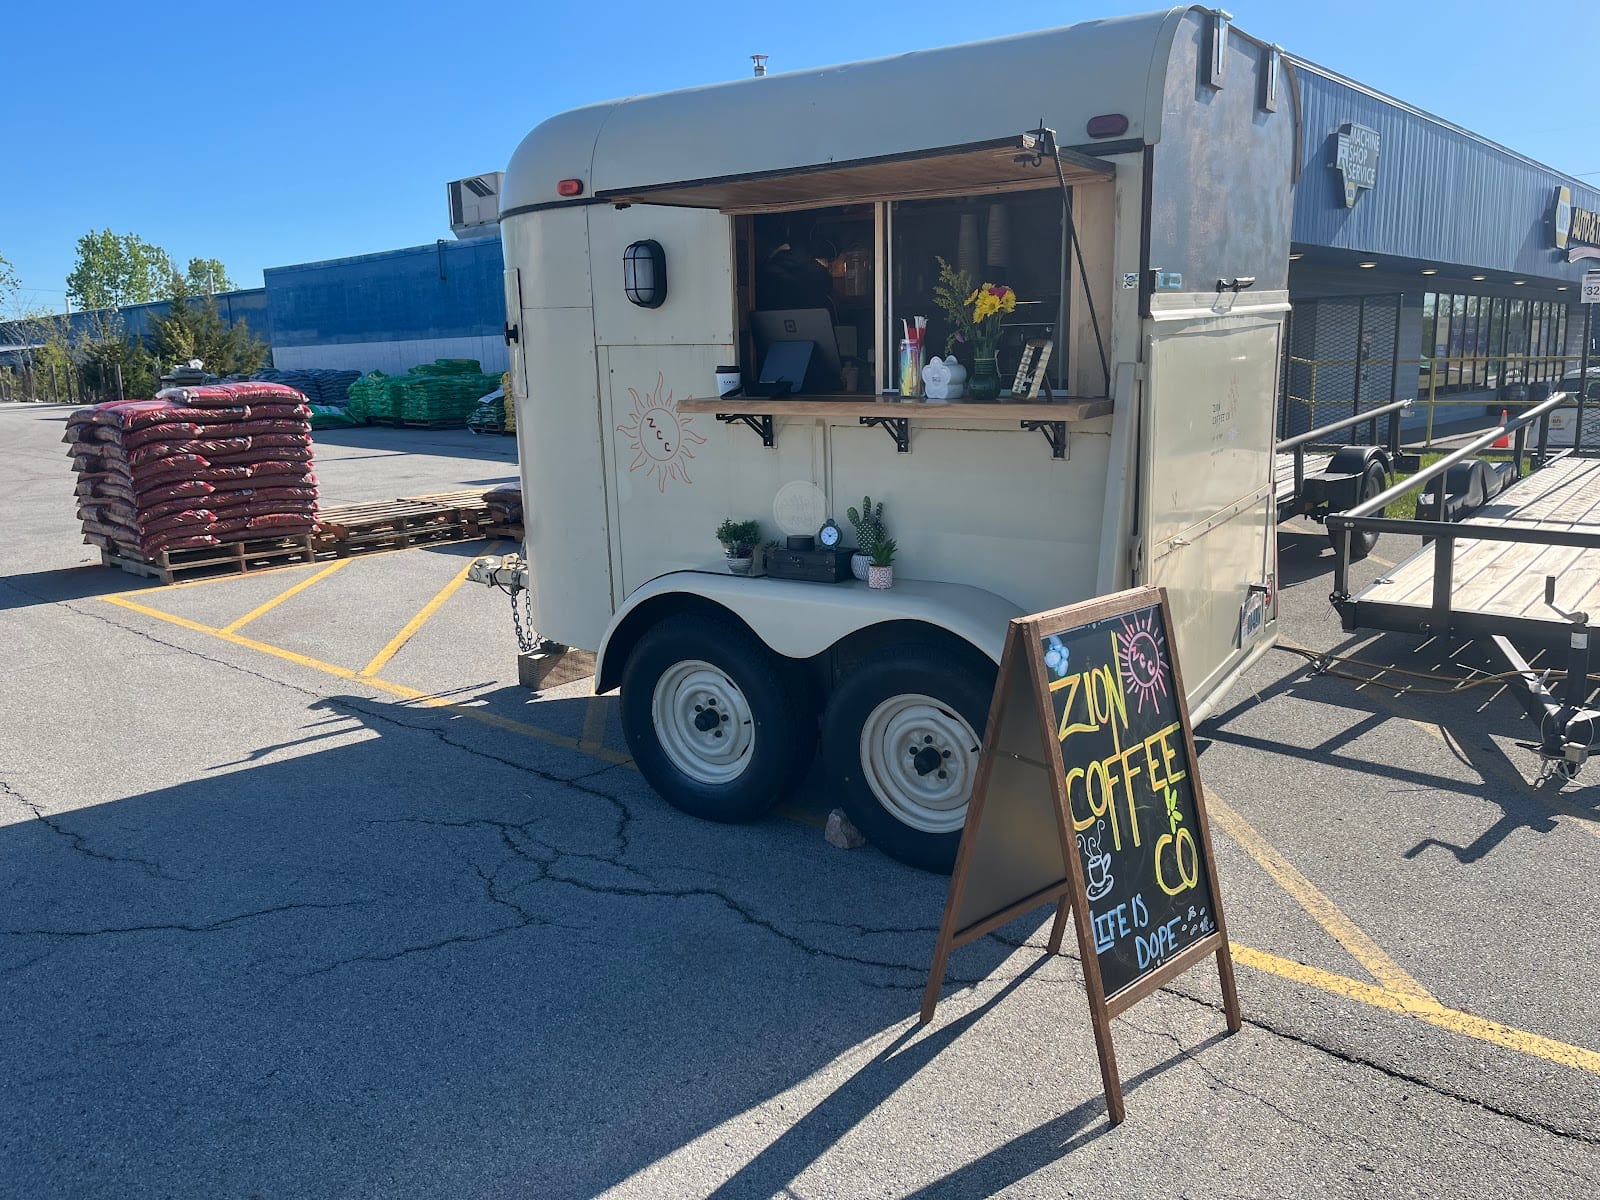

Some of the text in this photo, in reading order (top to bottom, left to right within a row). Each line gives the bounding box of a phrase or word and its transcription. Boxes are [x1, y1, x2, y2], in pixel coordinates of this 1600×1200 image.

[1349, 144, 1368, 165] SHOP
[1350, 126, 1380, 151] MACHINE
[1348, 162, 1376, 184] SERVICE
[1048, 629, 1129, 755] ZION
[1066, 721, 1186, 851] COFFEE
[1154, 827, 1198, 895] CO
[1090, 893, 1150, 955] LIFE IS
[1135, 916, 1181, 969] DOPE
